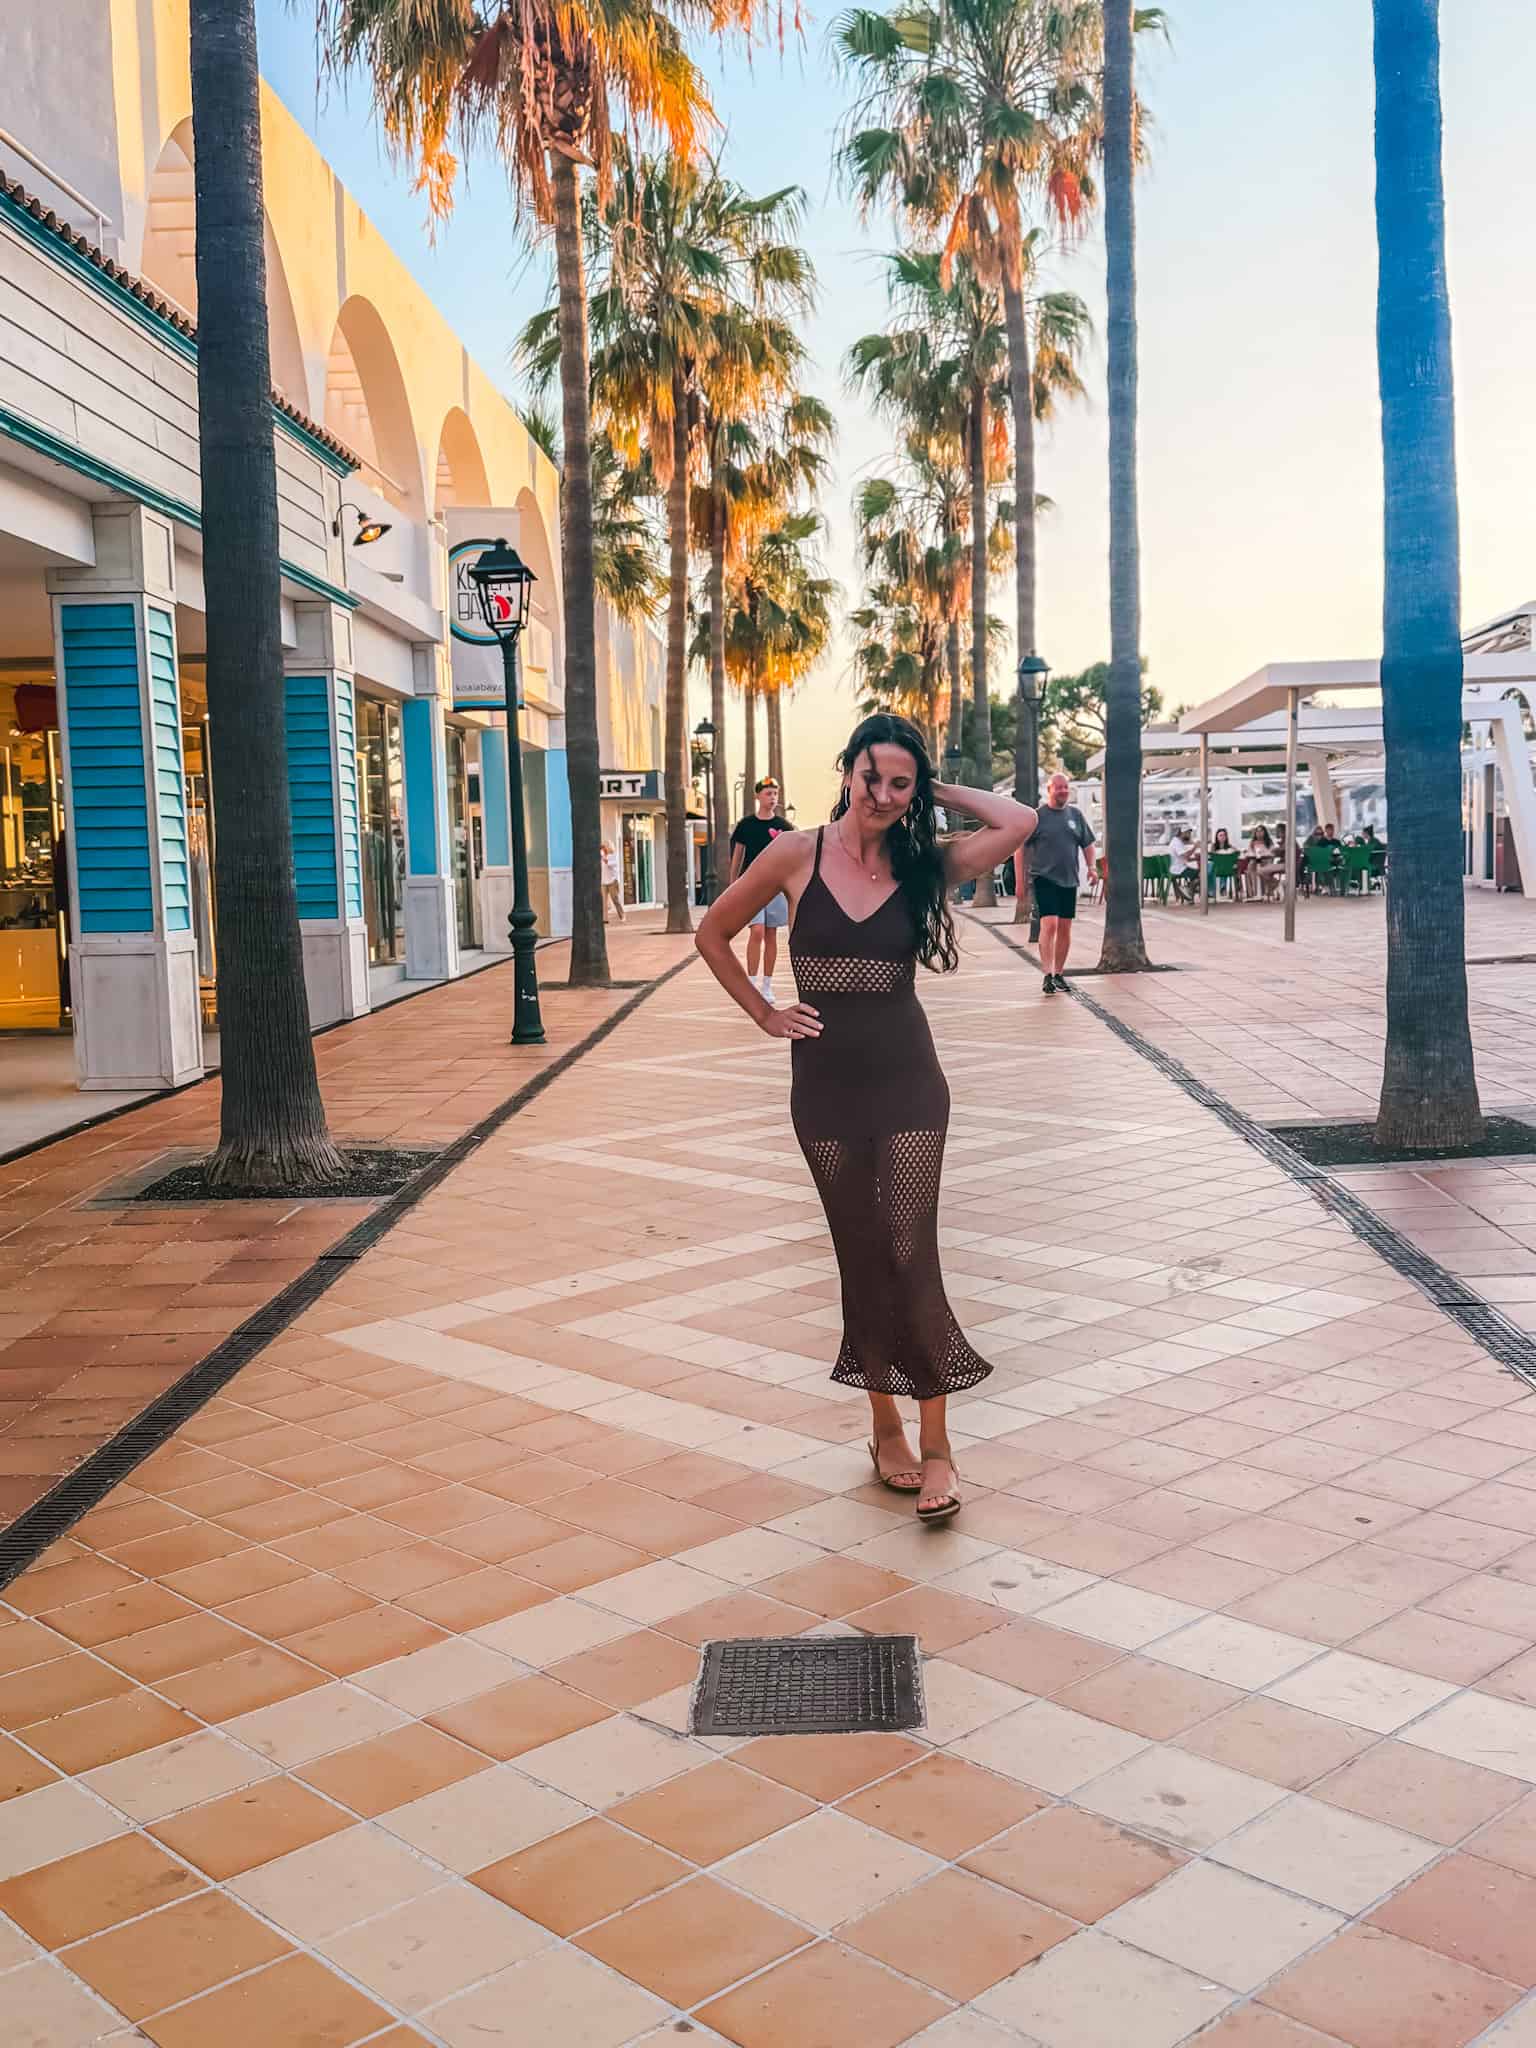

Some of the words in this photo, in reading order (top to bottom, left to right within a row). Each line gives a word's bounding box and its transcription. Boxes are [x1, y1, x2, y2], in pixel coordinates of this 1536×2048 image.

[458, 592, 494, 620] BA
[456, 681, 505, 693] koalabay.c
[600, 779, 640, 793] RT
